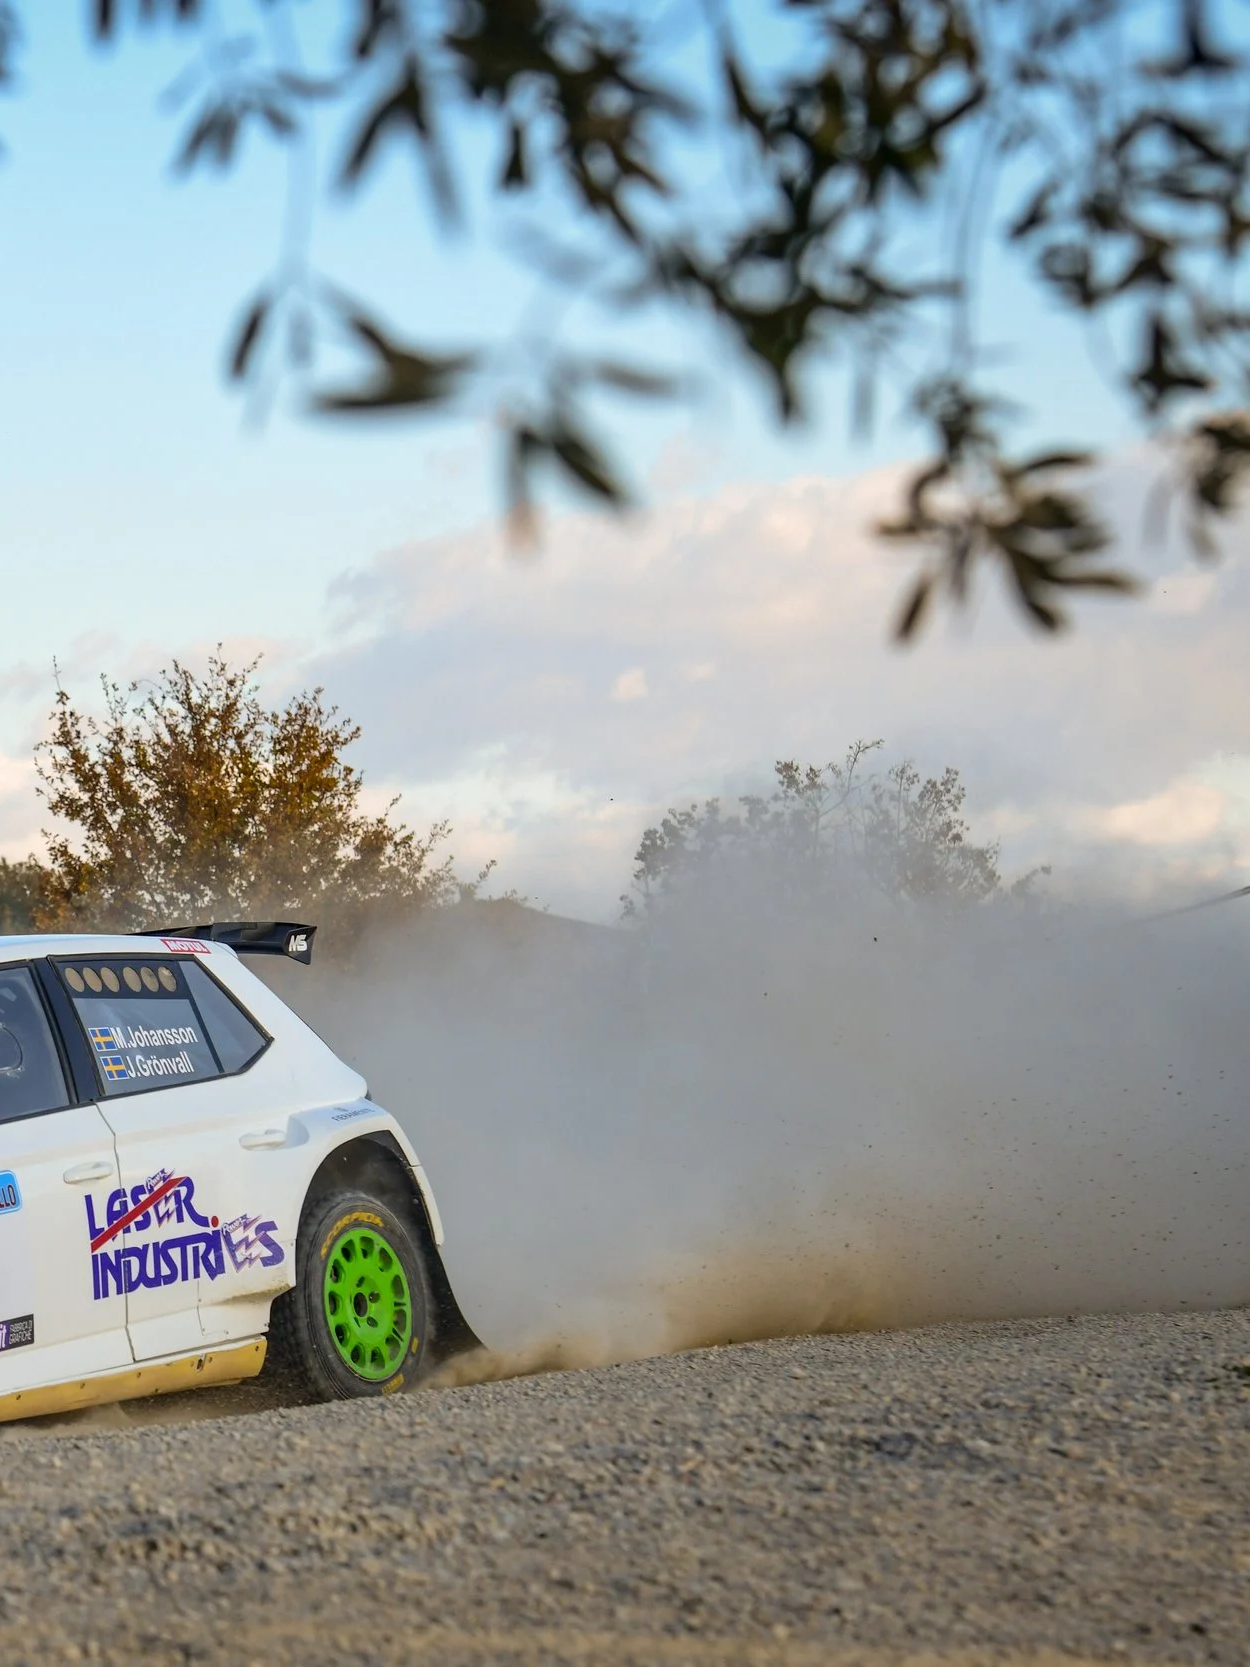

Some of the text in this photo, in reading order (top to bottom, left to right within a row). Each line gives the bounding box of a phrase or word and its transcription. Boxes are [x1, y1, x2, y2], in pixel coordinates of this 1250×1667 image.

[167, 940, 206, 952] MOTUL
[288, 934, 308, 952] MS
[110, 1025, 198, 1049] M.Johansson
[126, 1051, 195, 1078] J.Grönvall
[91, 1217, 285, 1301] INDUSTRIES
